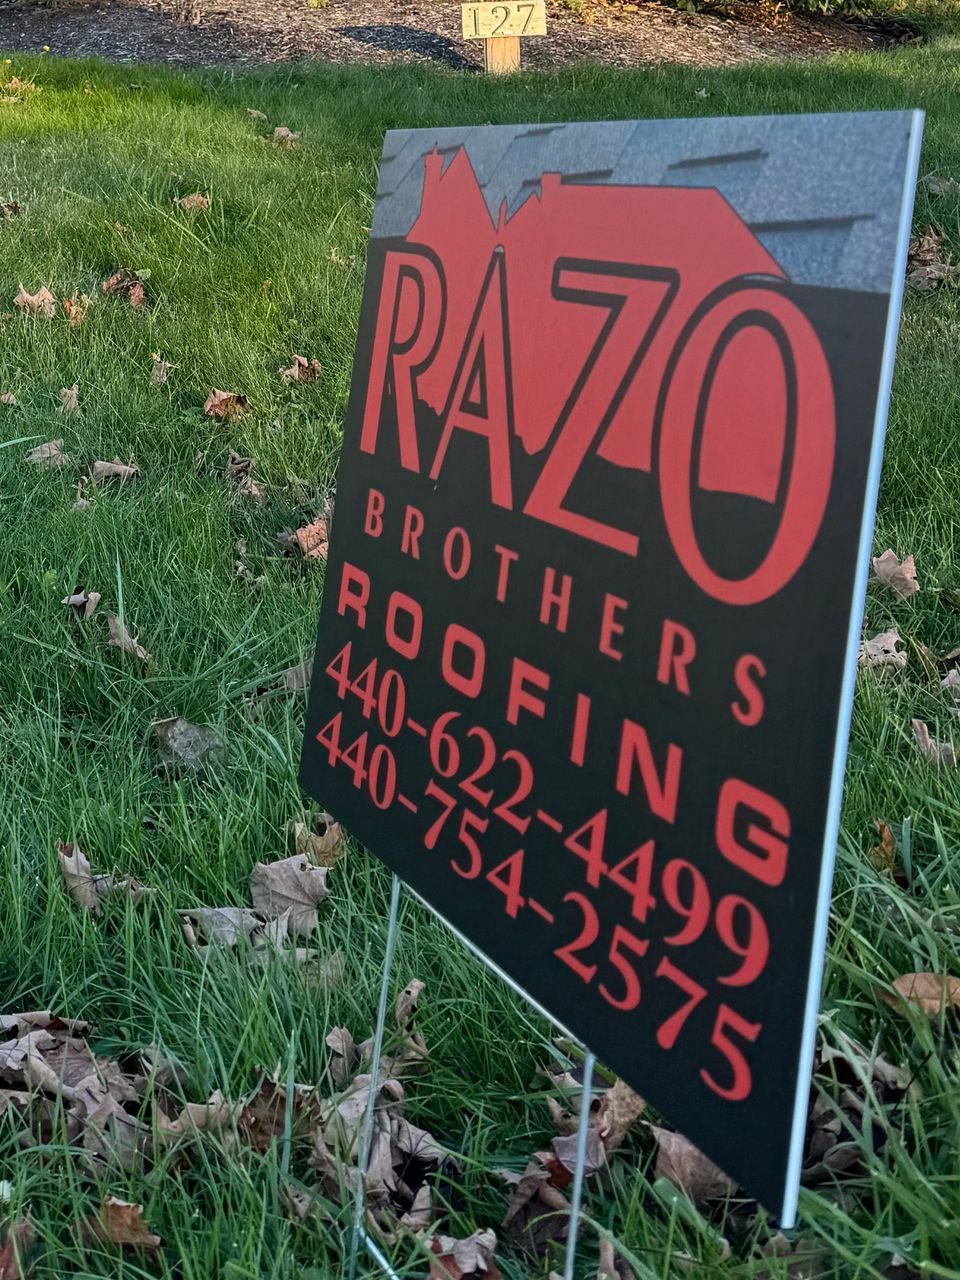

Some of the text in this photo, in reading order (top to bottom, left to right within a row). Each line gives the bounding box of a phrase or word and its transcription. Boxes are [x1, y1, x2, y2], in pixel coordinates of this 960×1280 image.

[468, 3, 536, 38] 127
[359, 250, 837, 606] RAZO
[337, 562, 791, 887] ROOFING
[363, 487, 767, 727] BROTHERS
[315, 711, 762, 1102] 440-754-2575
[325, 641, 770, 987] 440-622-4499
